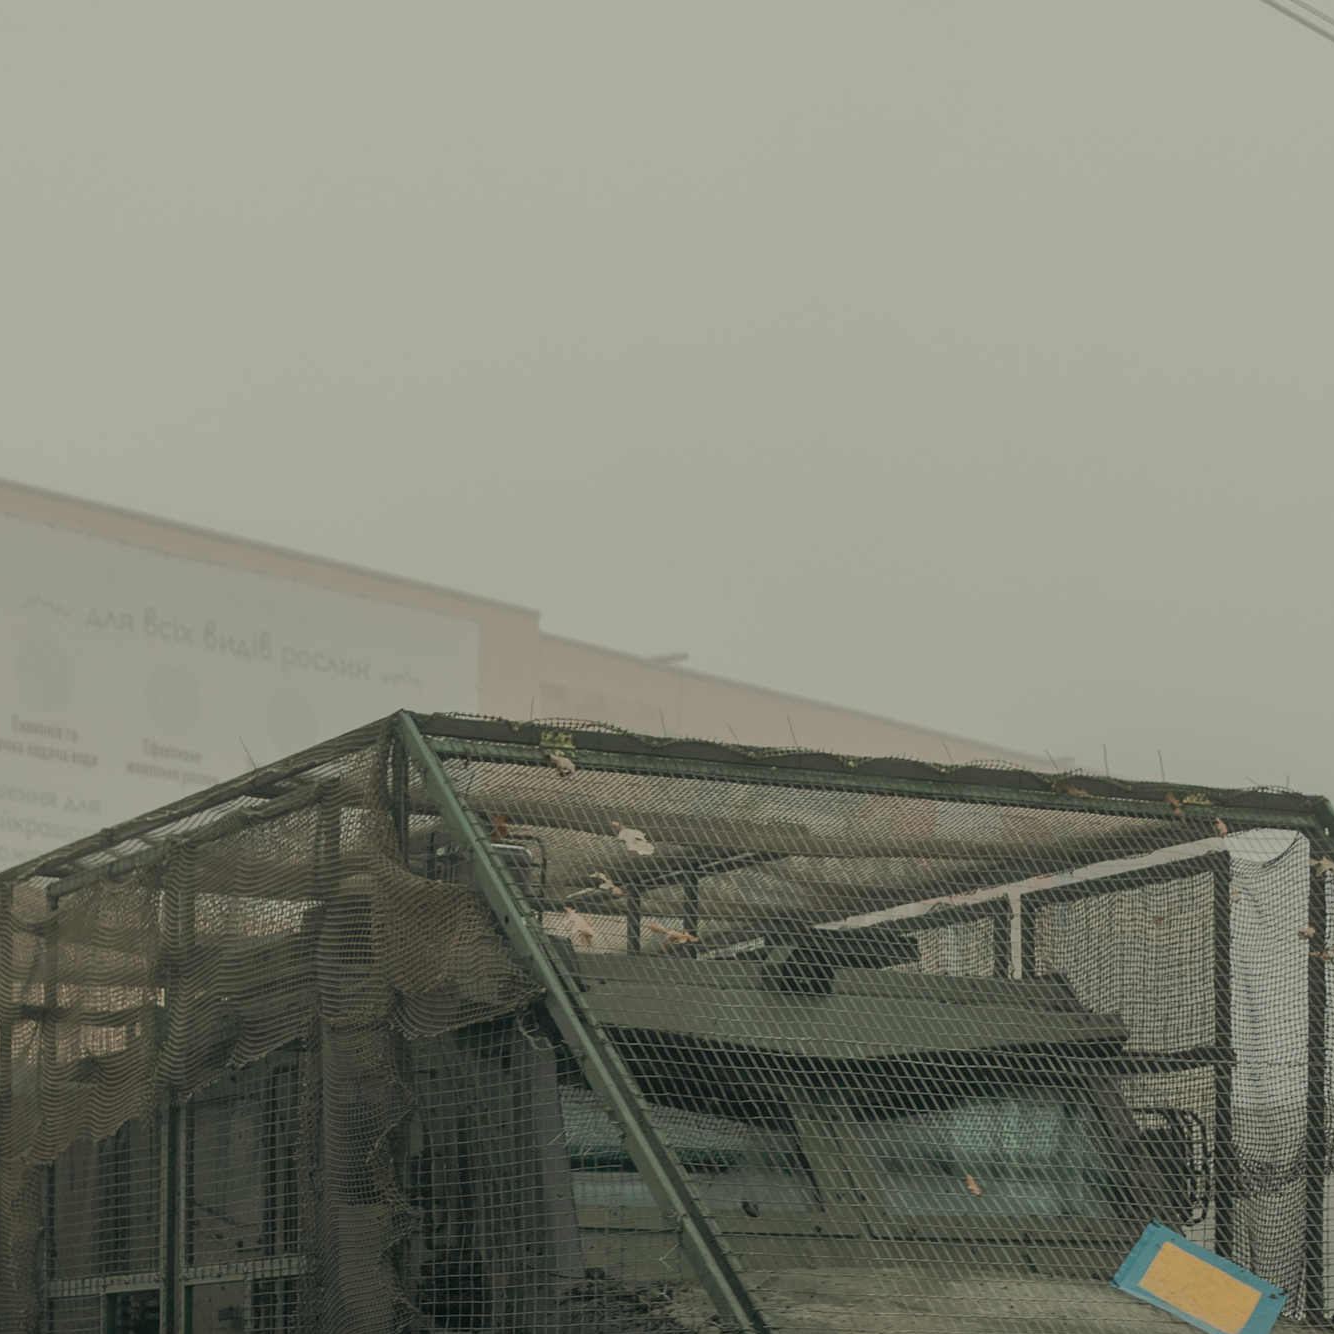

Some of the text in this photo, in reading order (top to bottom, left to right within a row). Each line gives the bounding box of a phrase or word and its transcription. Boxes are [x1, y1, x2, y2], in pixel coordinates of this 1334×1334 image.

[83, 605, 371, 682] для всіх видів рослин
[62, 795, 102, 816] для
